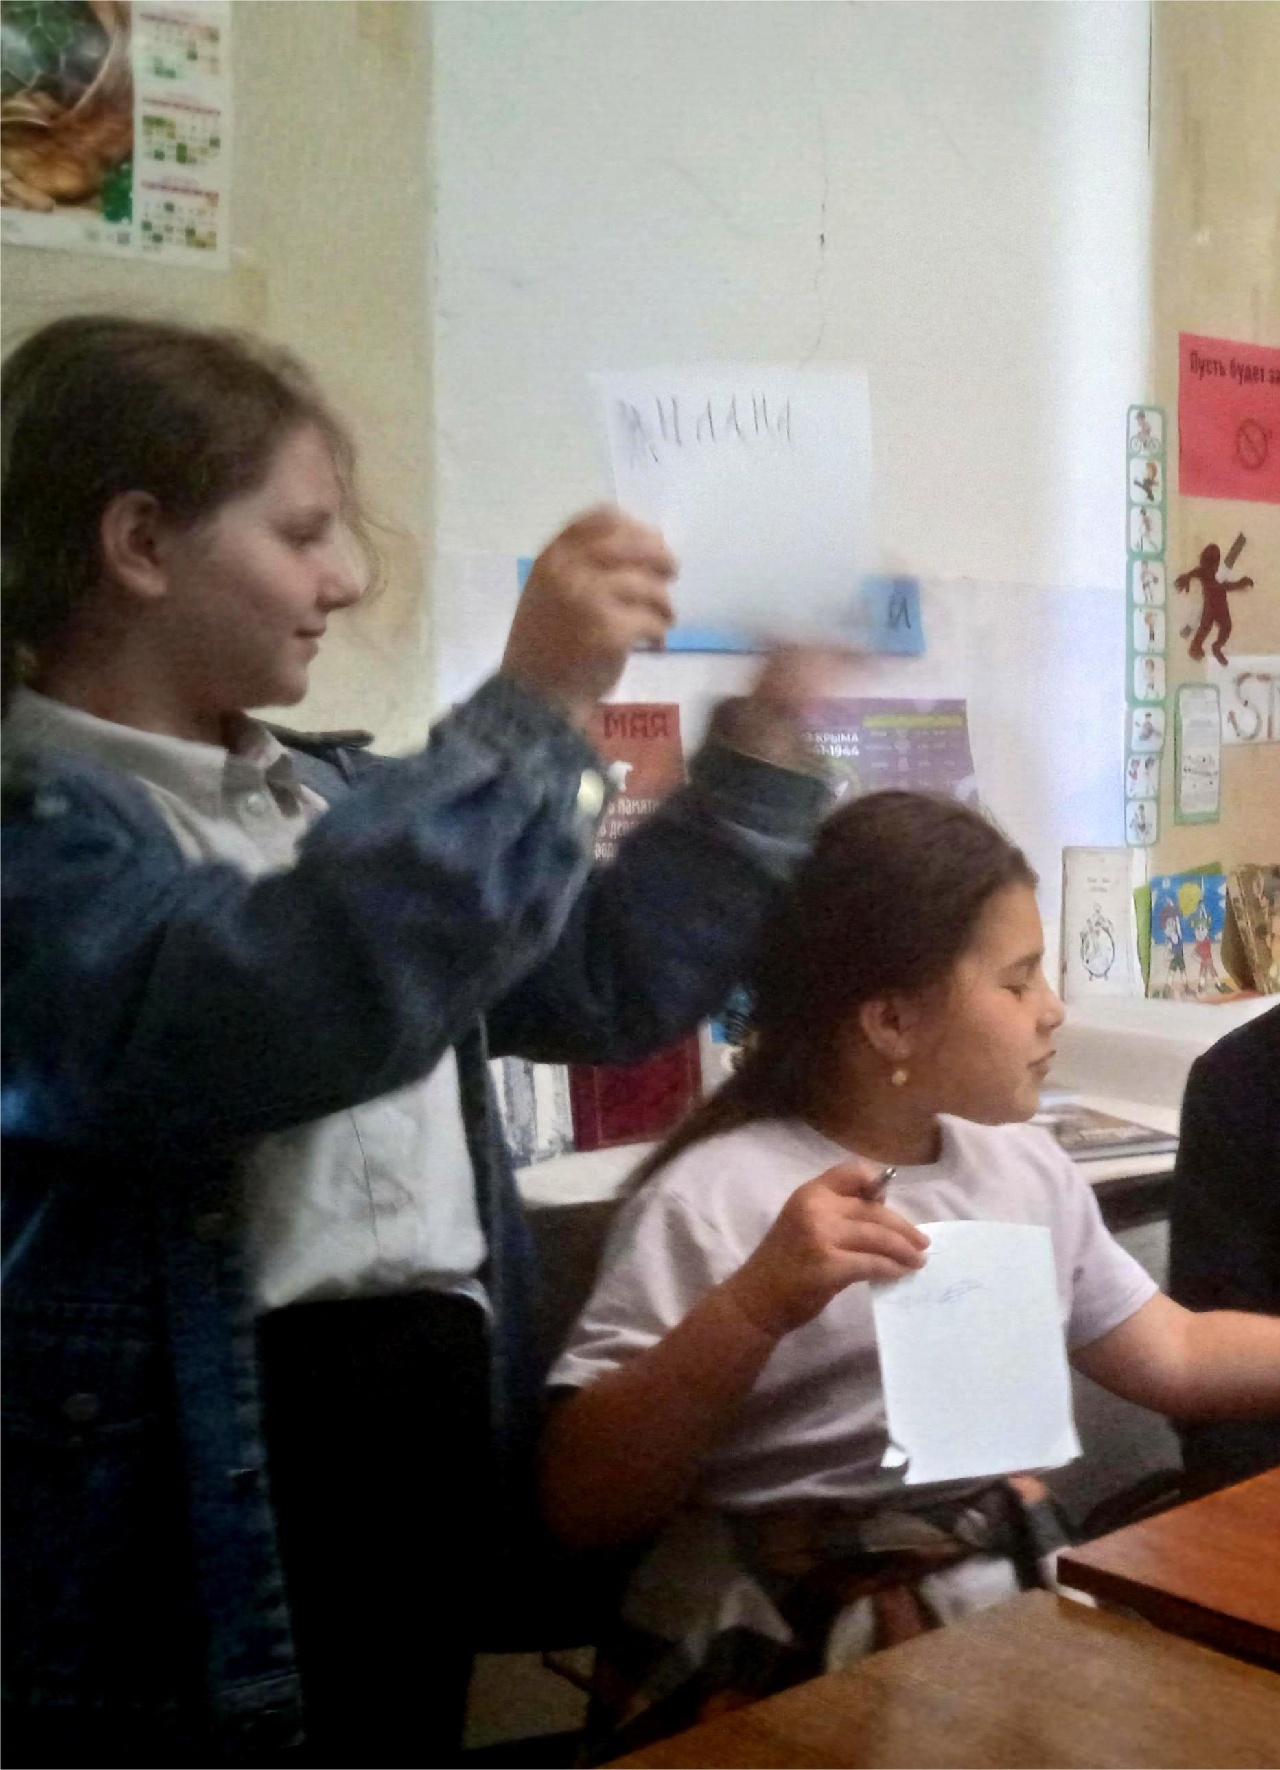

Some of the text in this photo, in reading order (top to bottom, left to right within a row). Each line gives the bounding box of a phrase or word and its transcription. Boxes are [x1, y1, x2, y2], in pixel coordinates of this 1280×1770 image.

[1190, 350, 1227, 381] Пусть
[1229, 358, 1265, 386] будет
[604, 712, 669, 739] МАЯ
[815, 731, 859, 743] КРЫМА
